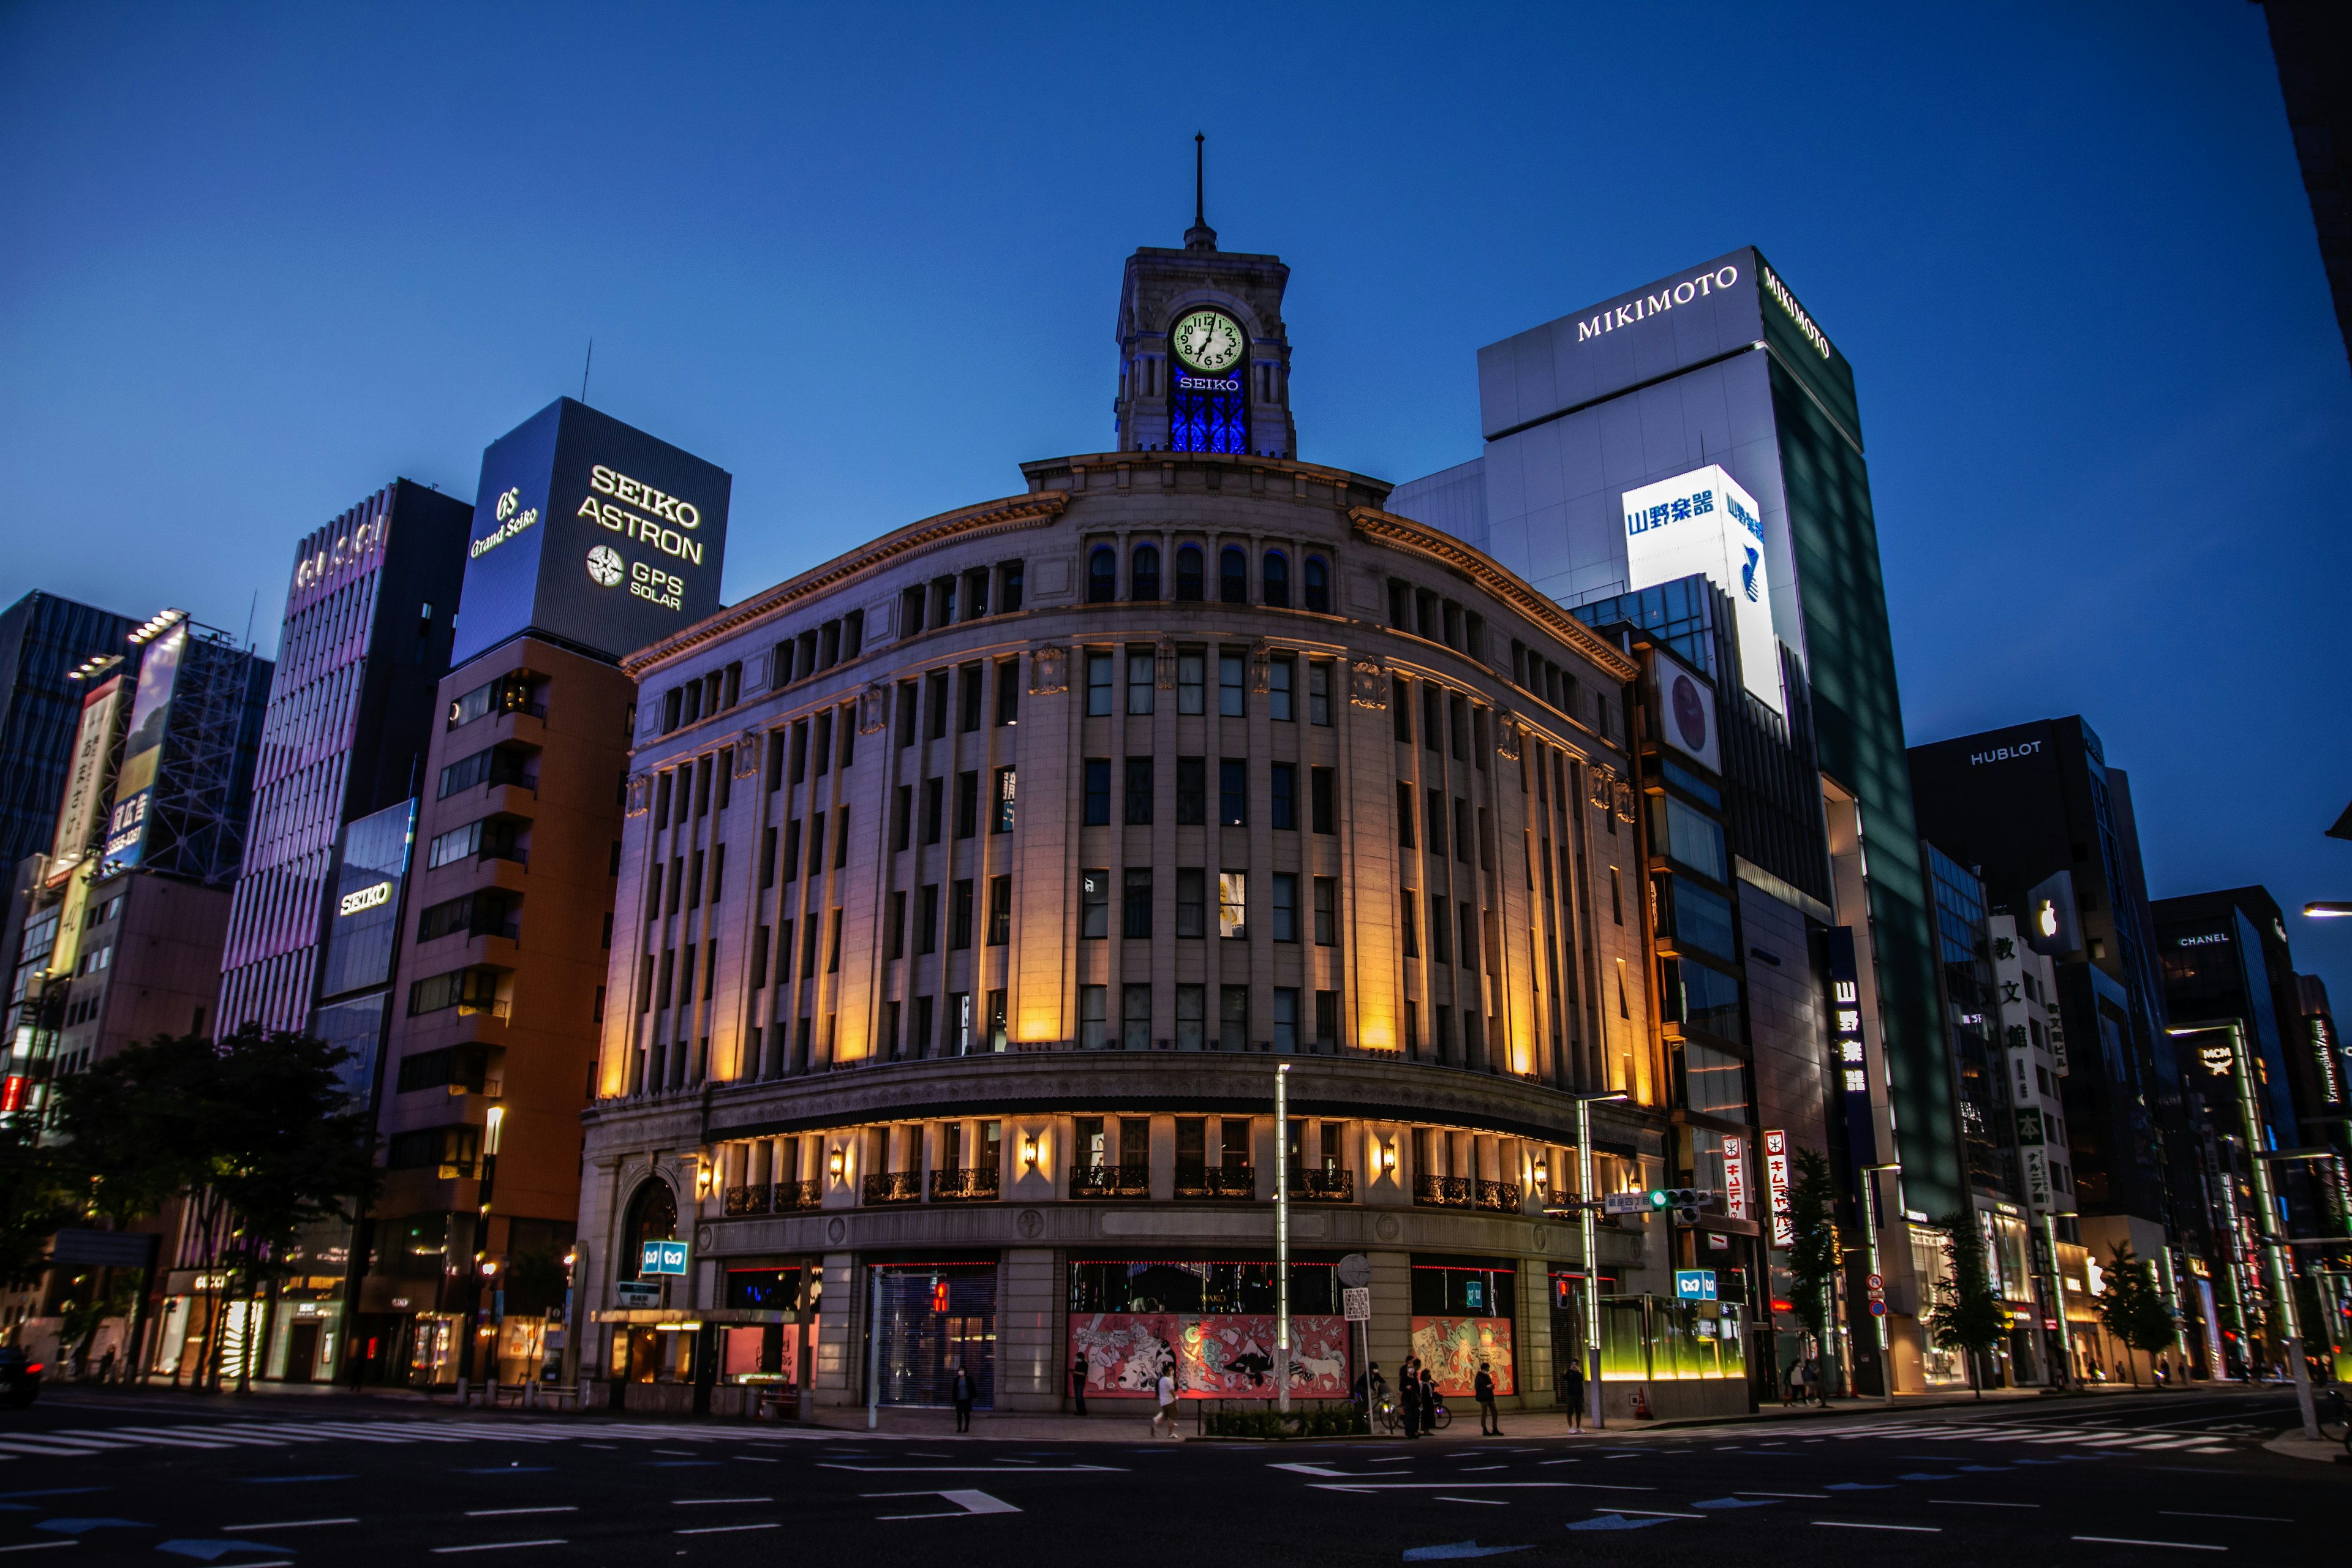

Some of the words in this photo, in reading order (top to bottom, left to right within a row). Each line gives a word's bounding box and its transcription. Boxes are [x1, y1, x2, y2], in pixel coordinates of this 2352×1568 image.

[1578, 266, 1738, 342] MIKIMOTO
[1765, 266, 1830, 359] MIKIMOTO
[1185, 325, 1193, 334] 10
[1194, 318, 1200, 327] 11
[1219, 320, 1221, 328] 1
[1225, 327, 1232, 336] 2
[1180, 335, 1188, 344] 9
[1185, 345, 1193, 354] 8
[1229, 338, 1236, 347] 3
[1194, 352, 1202, 362] 7
[1204, 356, 1212, 366] 6
[1216, 355, 1223, 363] 5
[1224, 348, 1233, 357] 4
[1180, 377, 1238, 391] SEIKO
[496, 486, 519, 522] GS
[590, 464, 701, 529] SEIKO
[1627, 490, 1714, 535] 山野楽器
[1726, 492, 1764, 544] 山野楽器
[470, 524, 506, 559] Grand
[505, 508, 538, 538] Seiko
[578, 496, 703, 565] ASTRON
[632, 562, 684, 596] GPS
[630, 581, 681, 611] SOLAR
[1971, 741, 2041, 766] HUBLOT
[340, 881, 391, 916] SEIKO
[2180, 933, 2230, 947] CHANEL
[1994, 937, 2027, 1048] 教文館
[1836, 982, 1866, 1091] 山野楽器
[2203, 1047, 2231, 1059] MCM
[2018, 1114, 2040, 1140] 本
